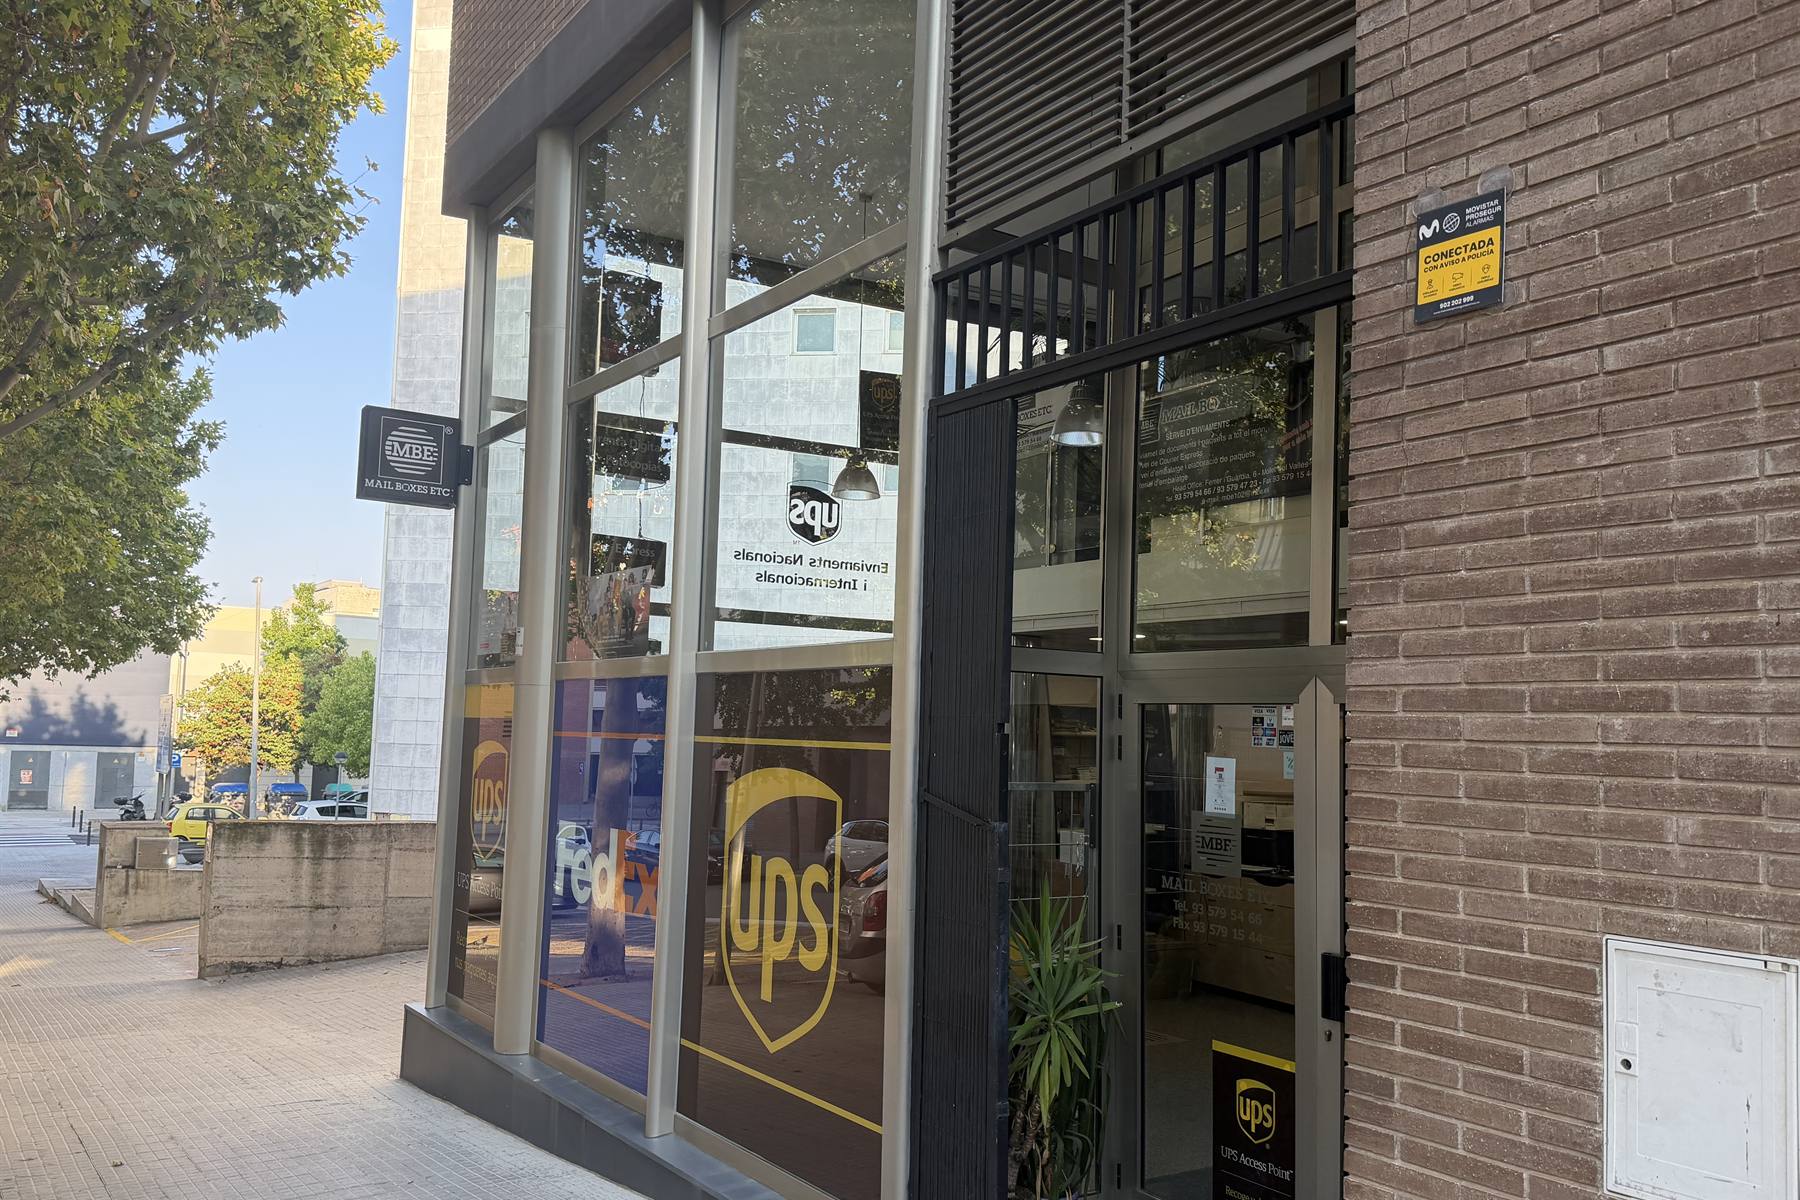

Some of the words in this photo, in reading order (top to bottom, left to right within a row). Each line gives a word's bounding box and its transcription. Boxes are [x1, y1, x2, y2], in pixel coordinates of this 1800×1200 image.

[1465, 199, 1499, 214] MOVISTAR
[1465, 205, 1502, 221] PROSEGUR
[1465, 214, 1495, 228] ALARMAS
[1424, 237, 1495, 265] CONECTADA
[1424, 264, 1438, 273] CON
[1439, 258, 1460, 269] AVISO
[1467, 248, 1495, 261] POLICÍA
[1439, 300, 1451, 309] 902
[1451, 297, 1463, 306] 202
[1166, 429, 1186, 441] SERVEI
[392, 442, 434, 461] MBE
[365, 478, 394, 490] MAIL
[395, 482, 428, 494] BOXES
[430, 487, 450, 497] ETC
[1174, 493, 1182, 501] 93
[1183, 491, 1194, 499] 579
[1195, 489, 1202, 497] 54
[1217, 485, 1225, 493] 93
[1226, 484, 1238, 492] 579
[1239, 481, 1248, 490] 47
[473, 778, 504, 842] ups
[457, 872, 469, 889] UPS
[1161, 874, 1196, 893] MAIL
[1200, 879, 1243, 900] BOXES
[1192, 902, 1205, 915] 93
[1208, 904, 1227, 919] 579
[1231, 909, 1244, 922] 54
[1248, 912, 1263, 926] 66
[730, 851, 829, 1003] ups
[1173, 915, 1191, 931] Fax
[1193, 920, 1206, 934] 93
[1209, 923, 1228, 938] 579
[1232, 928, 1245, 941] 15
[1248, 931, 1264, 945] 44
[1239, 1095, 1273, 1133] ups
[1221, 1145, 1238, 1162] UPS
[1239, 1152, 1267, 1173] Access
